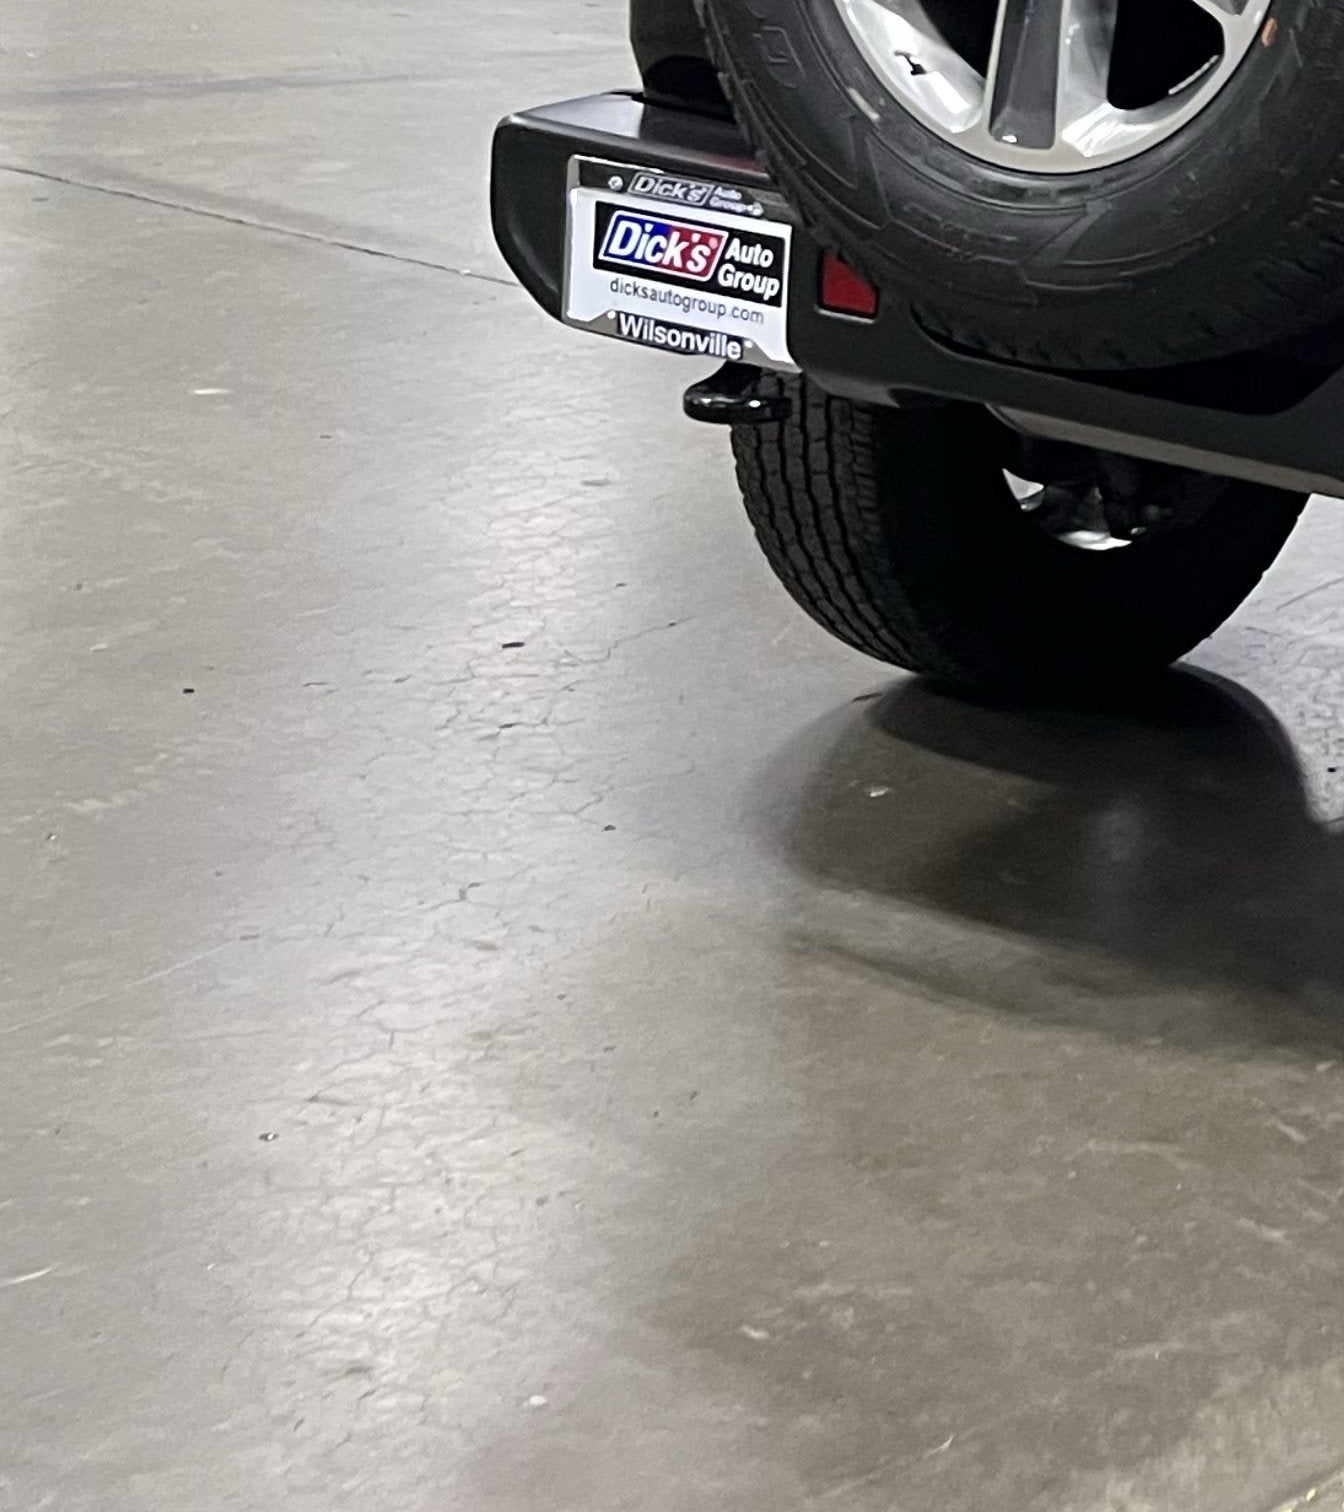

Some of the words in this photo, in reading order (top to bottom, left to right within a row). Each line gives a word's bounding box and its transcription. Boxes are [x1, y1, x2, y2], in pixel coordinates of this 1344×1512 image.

[634, 176, 707, 202] Dick's
[608, 220, 712, 273] Dick's
[724, 238, 774, 268] Auto
[718, 263, 780, 301] Group
[620, 313, 742, 361] Wilsonville
